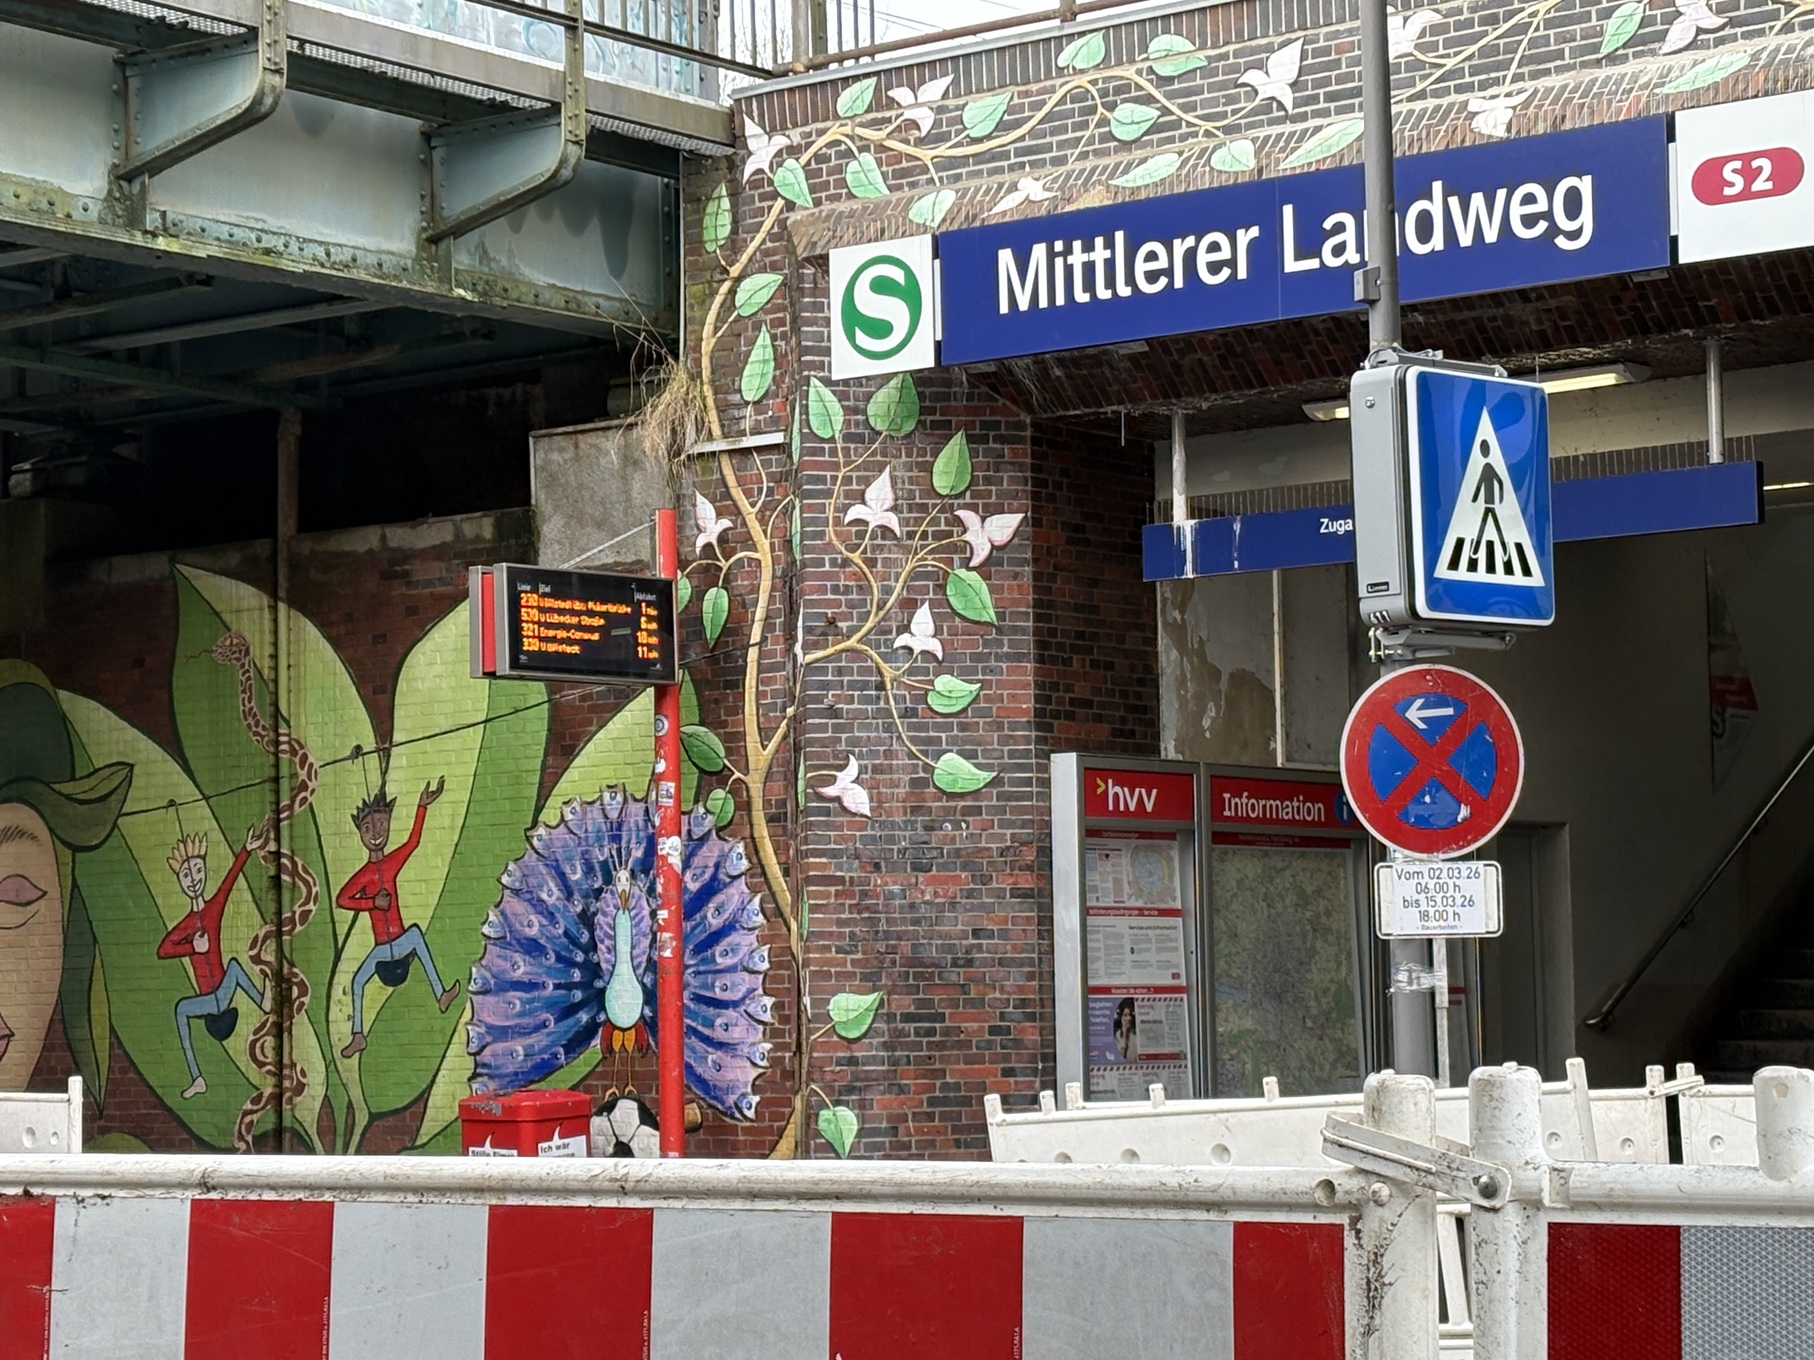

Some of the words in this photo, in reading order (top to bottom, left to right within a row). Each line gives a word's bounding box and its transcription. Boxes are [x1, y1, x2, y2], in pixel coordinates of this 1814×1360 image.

[1722, 157, 1774, 197] S2
[998, 226, 1259, 315] Mittlerer
[1281, 174, 1594, 274] Ladweg
[851, 261, 913, 354] S
[641, 602, 646, 615] 1
[1370, 610, 1391, 624] 611
[521, 622, 538, 636] 321
[637, 645, 648, 658] 11
[1107, 778, 1158, 813] hvv
[1222, 791, 1325, 822] Information
[1395, 867, 1424, 881] Vom
[1428, 866, 1481, 880] 02.03.26
[1415, 881, 1449, 895] 06:00
[1453, 881, 1461, 894] h
[1402, 896, 1421, 909] bis
[1425, 895, 1475, 908] 15.03.26
[1418, 909, 1449, 923] 18:00
[1453, 909, 1461, 922] h
[540, 1144, 553, 1154] Ich
[555, 1141, 571, 1151] wär
